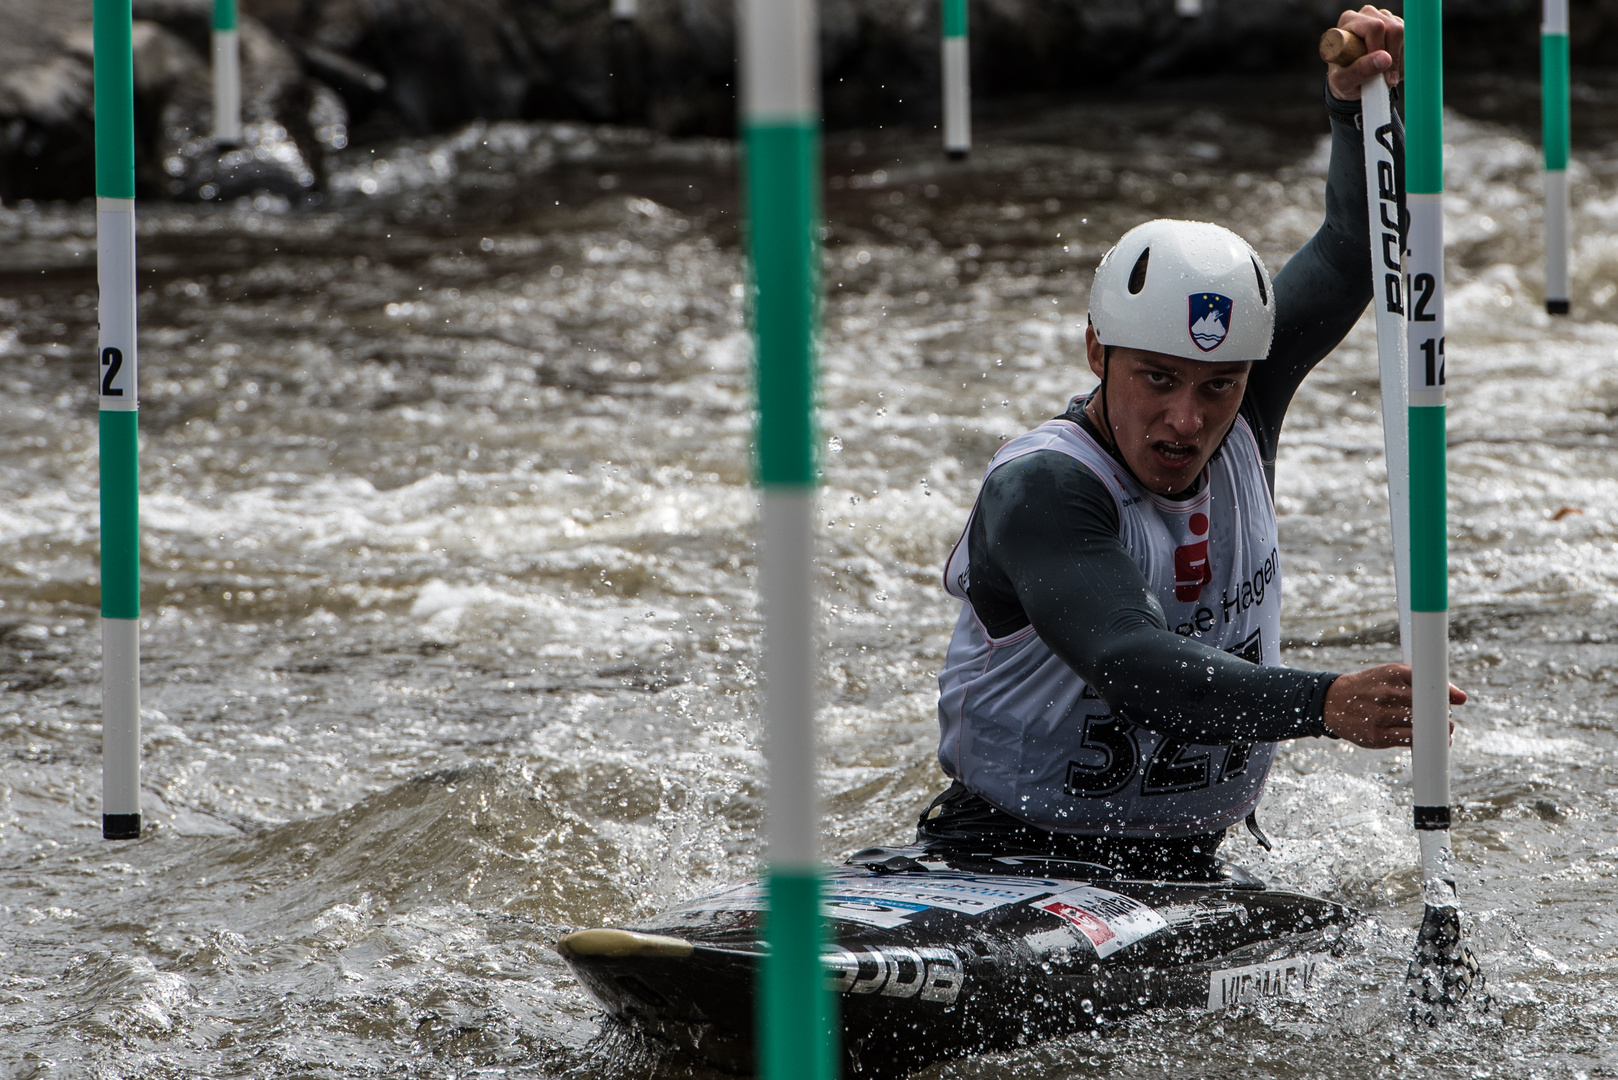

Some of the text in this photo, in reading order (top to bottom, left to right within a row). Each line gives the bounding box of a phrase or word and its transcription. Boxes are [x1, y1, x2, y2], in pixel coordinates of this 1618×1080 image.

[1407, 273, 1436, 321] 2
[98, 347, 124, 396] 2
[1223, 547, 1279, 623] Hagen
